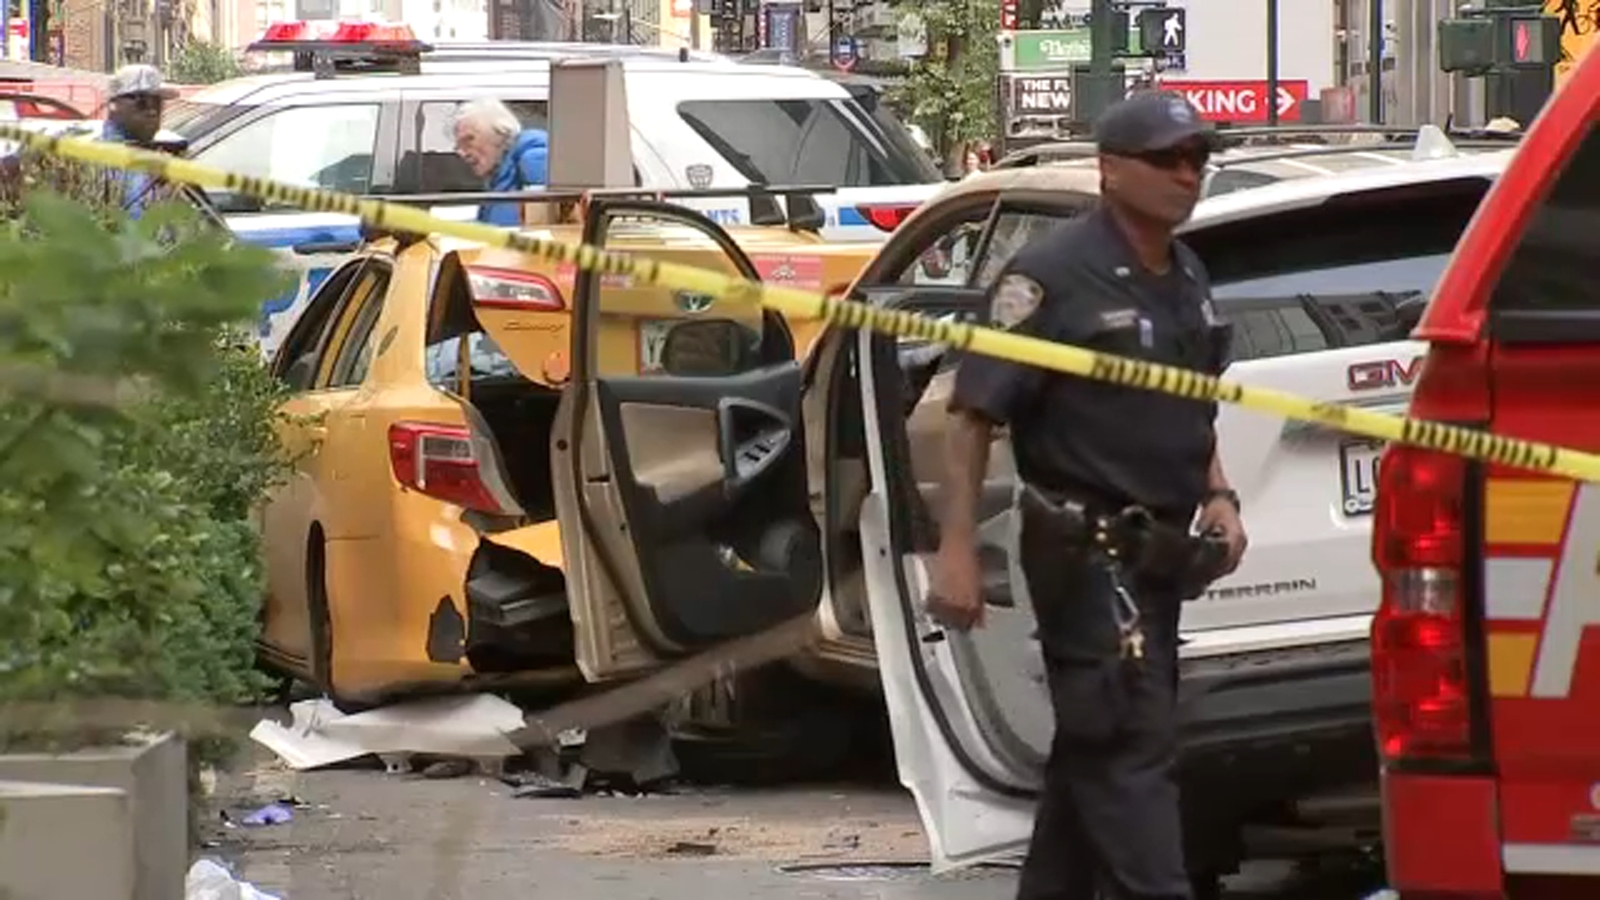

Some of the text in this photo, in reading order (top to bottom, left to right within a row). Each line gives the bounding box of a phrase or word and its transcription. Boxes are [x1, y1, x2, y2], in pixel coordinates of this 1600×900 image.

[1022, 79, 1051, 91] THE
[1021, 92, 1071, 109] NEW
[1185, 89, 1256, 113] KING
[1348, 355, 1423, 391] GM
[1206, 578, 1317, 600] TERRAIN
